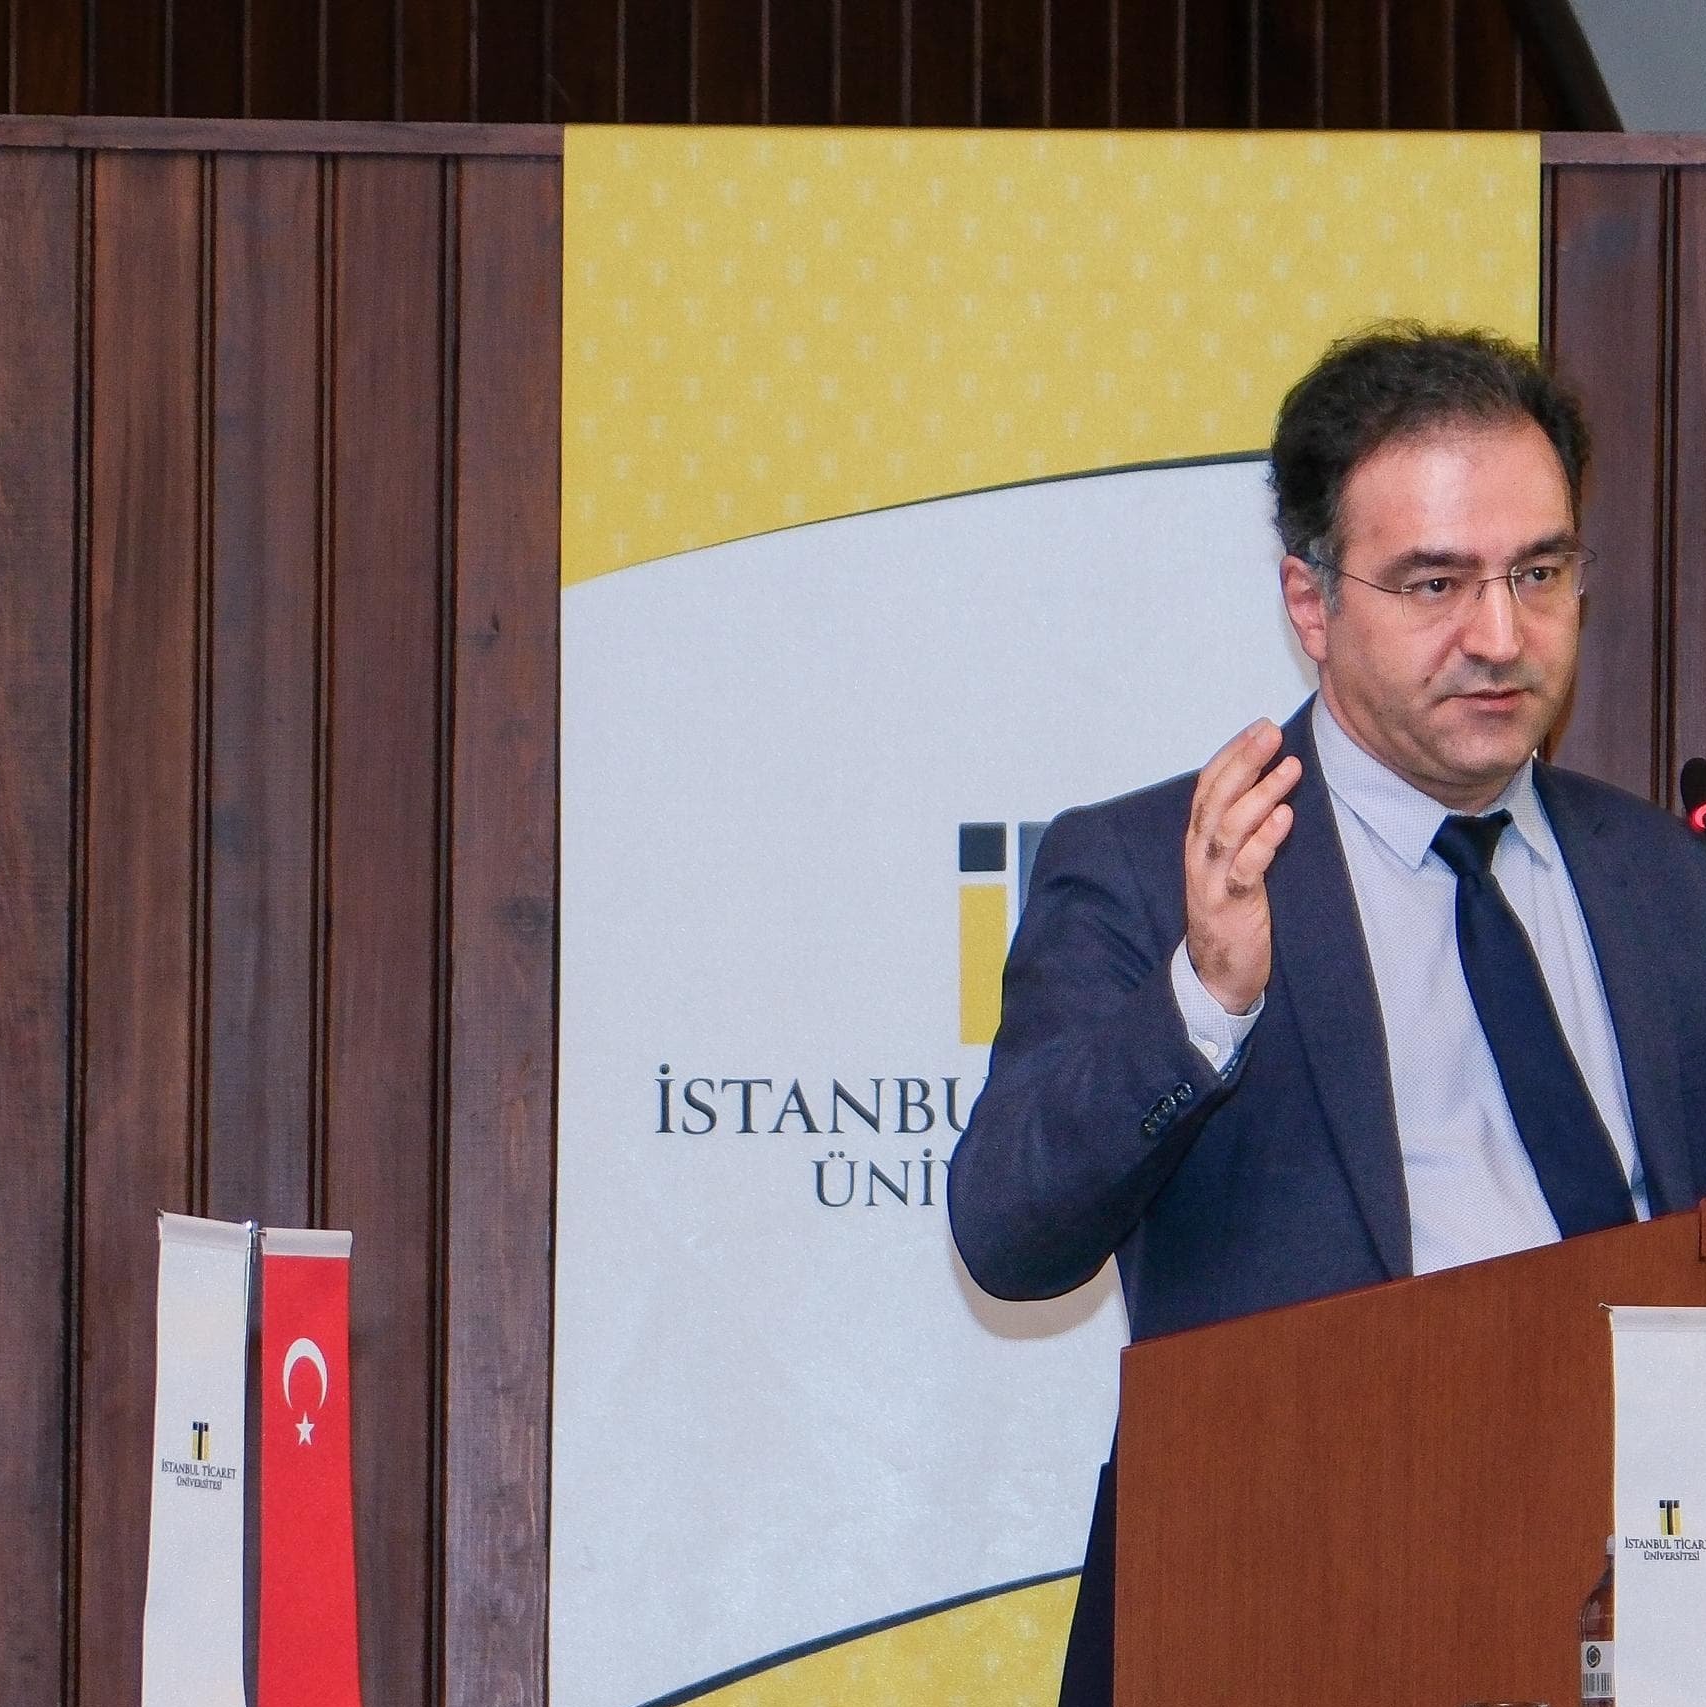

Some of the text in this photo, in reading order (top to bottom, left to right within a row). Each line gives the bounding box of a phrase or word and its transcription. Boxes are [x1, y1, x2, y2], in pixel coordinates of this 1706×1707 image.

[654, 1063, 989, 1135] İSTANBU
[812, 1148, 951, 1207] ÜNİ
[202, 1463, 236, 1480] TİCARET
[1624, 1536, 1671, 1549] İSTANBUL
[1644, 1550, 1700, 1561] ÜNİVERSİTESİ
